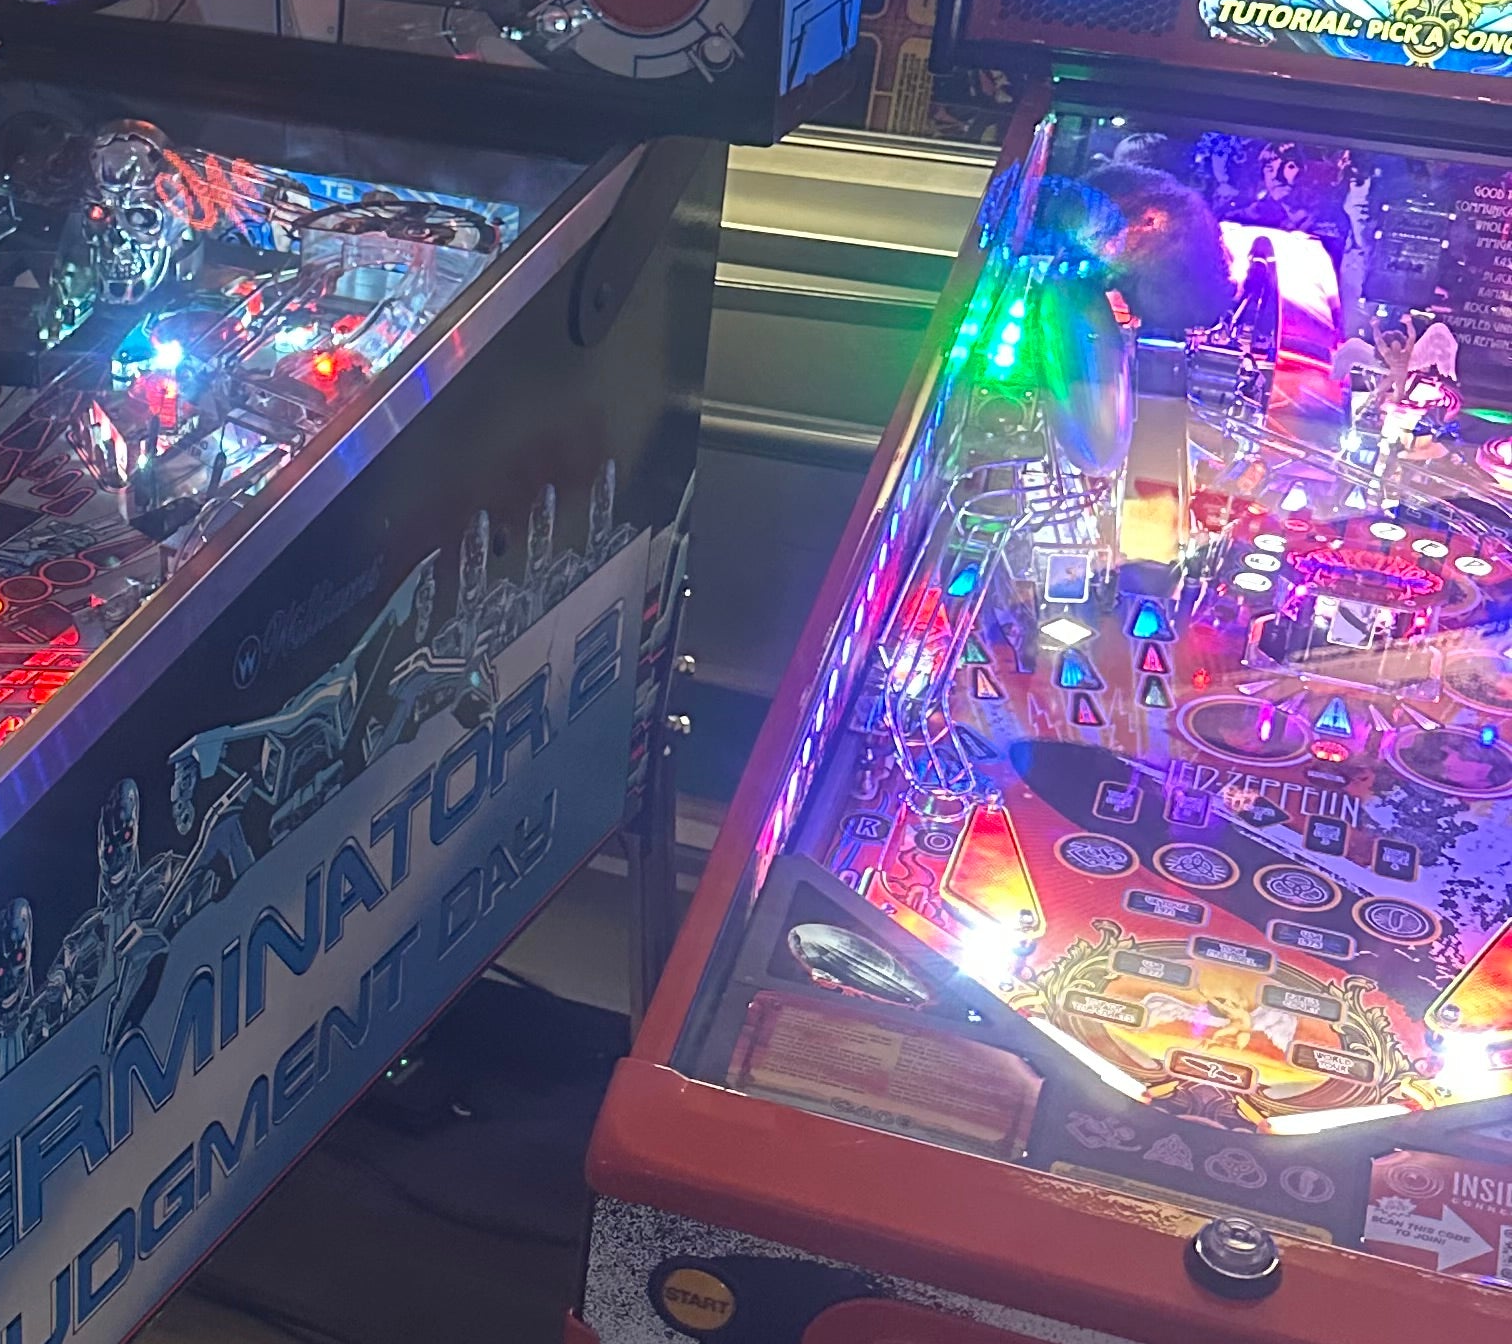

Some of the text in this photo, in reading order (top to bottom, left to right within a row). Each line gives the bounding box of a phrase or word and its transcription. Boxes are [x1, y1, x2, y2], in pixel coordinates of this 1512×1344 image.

[1218, 0, 1361, 36] TUTORIAL:
[1366, 19, 1421, 47] PICK
[1427, 26, 1444, 47] A
[1474, 185, 1505, 200] GOOD
[1455, 199, 1512, 217] COMMUNICA
[1475, 237, 1512, 252] IMMIGR
[1473, 334, 1512, 349] REMAIN
[439, 788, 558, 962] DAY
[1371, 1215, 1472, 1244] SCAN THIS CODE
[1395, 1229, 1447, 1246] TO JOIN!
[663, 1286, 733, 1316] START
